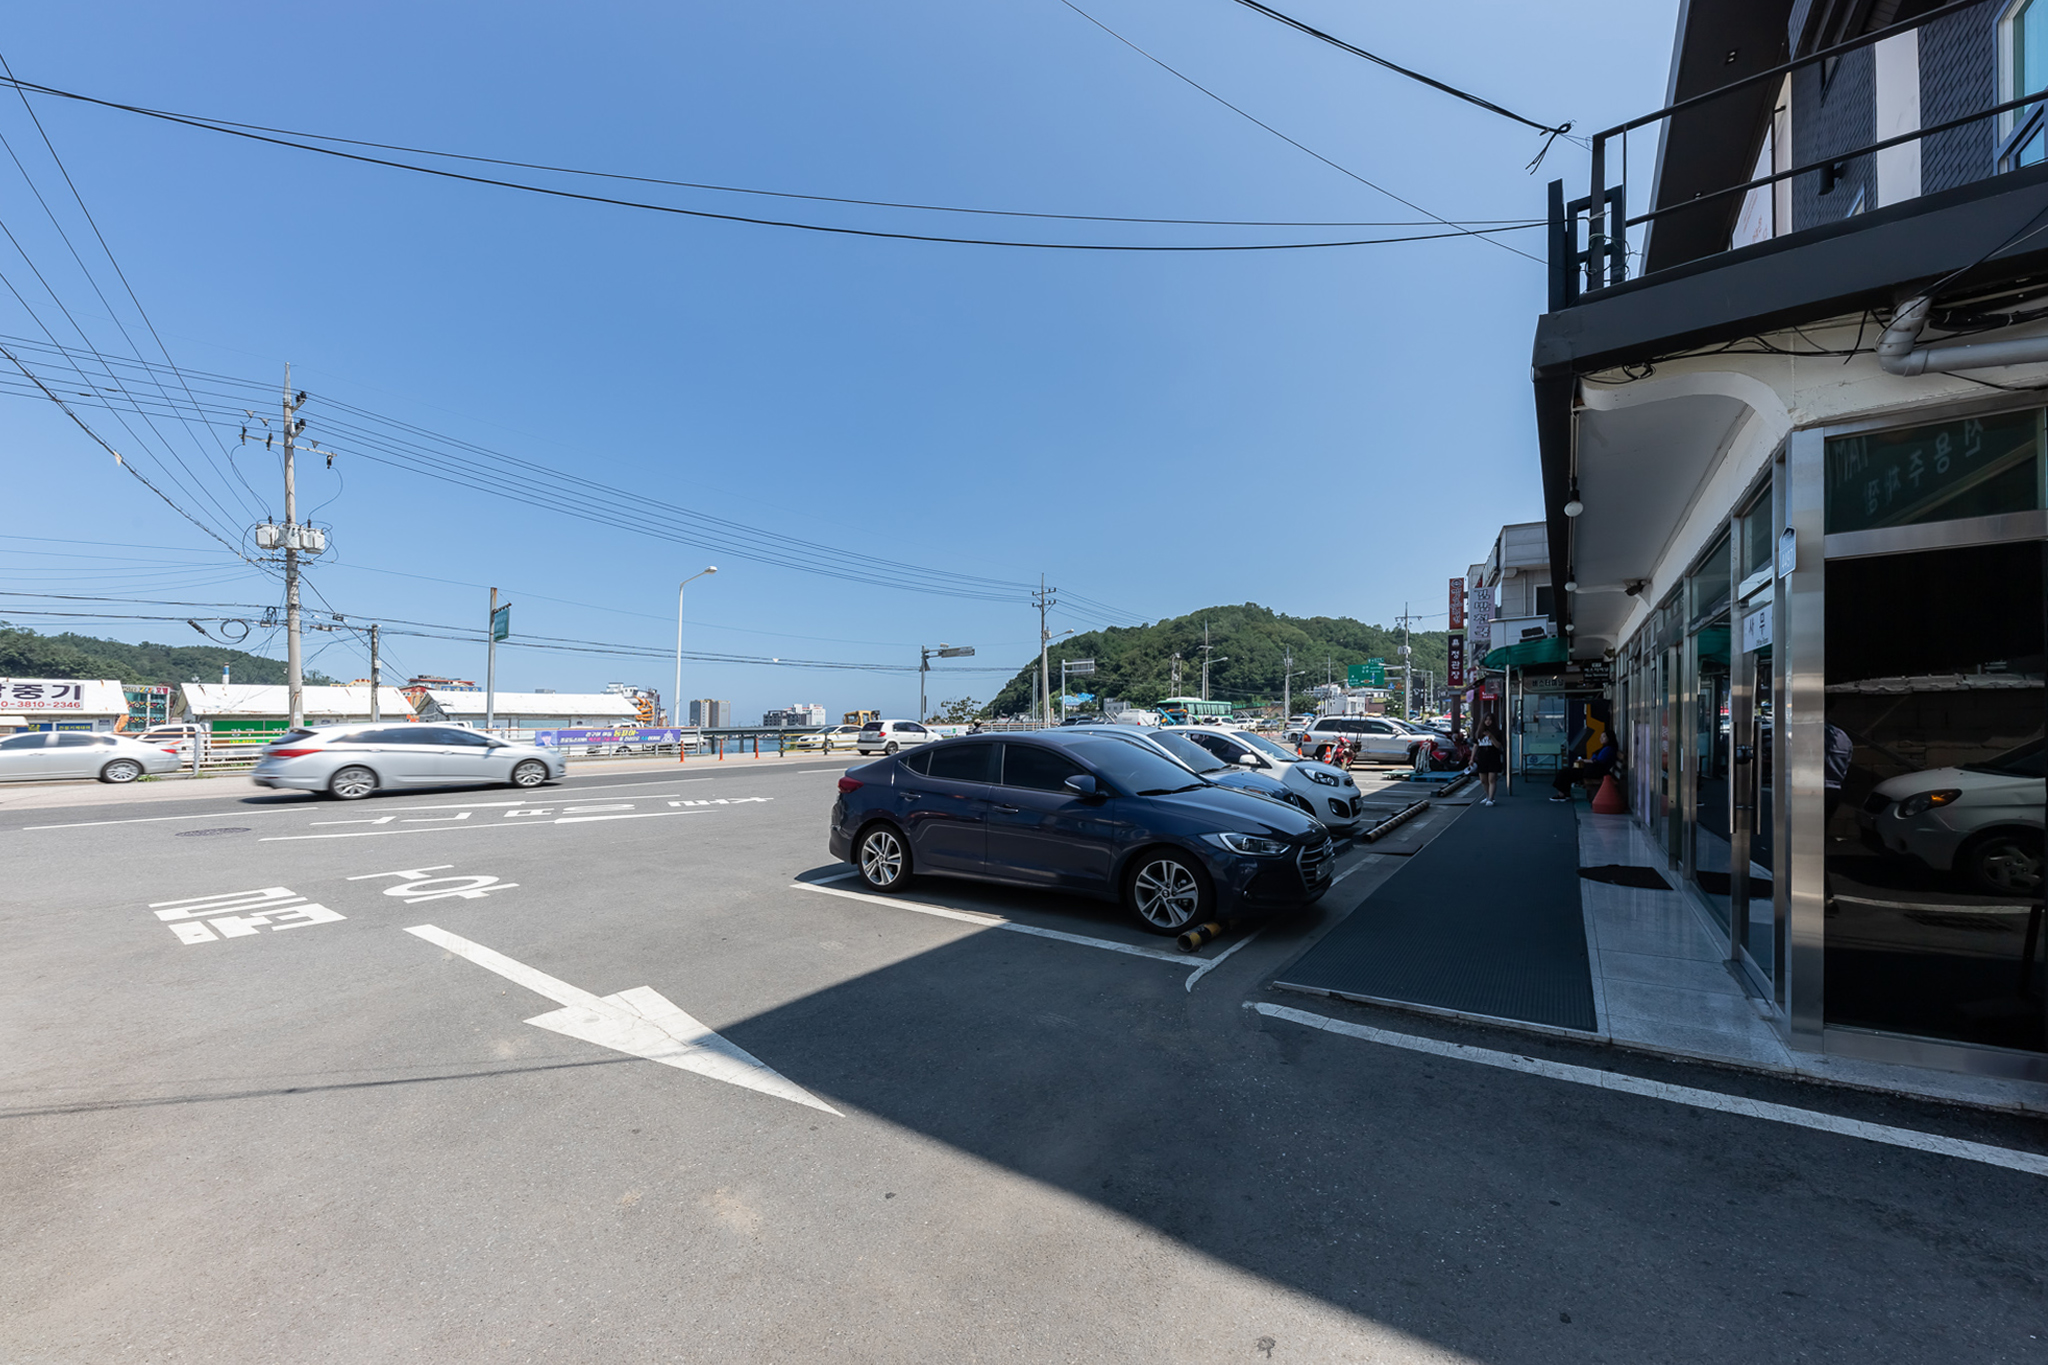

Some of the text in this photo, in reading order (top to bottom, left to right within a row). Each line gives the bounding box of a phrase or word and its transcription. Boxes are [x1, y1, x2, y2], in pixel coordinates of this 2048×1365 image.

[1473, 588, 1491, 637] 김밥천국
[1748, 612, 1766, 638] 사무
[1450, 650, 1461, 680] 정관장
[1532, 678, 1564, 687] 버스터미널
[148, 864, 520, 945] 호텔
